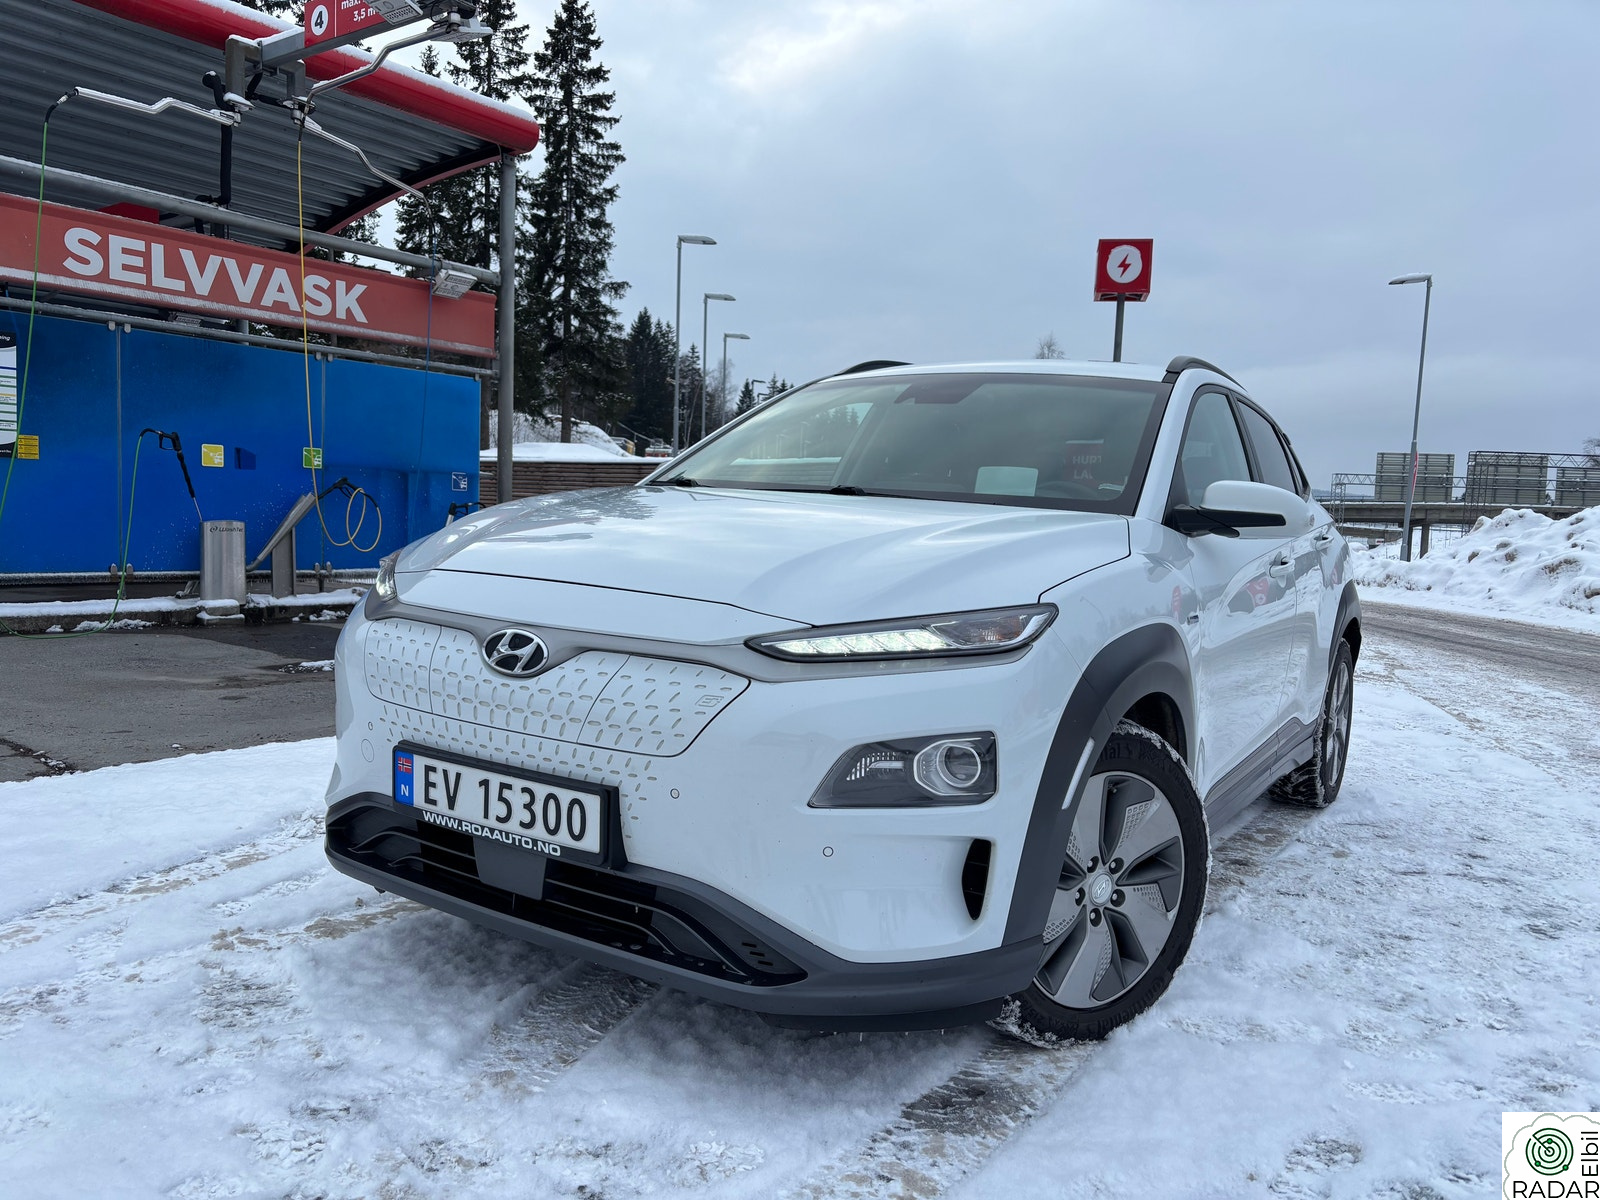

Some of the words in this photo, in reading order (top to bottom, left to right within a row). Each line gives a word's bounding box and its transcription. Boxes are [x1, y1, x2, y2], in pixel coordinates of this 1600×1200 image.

[314, 11, 324, 28] 4
[353, 8, 366, 21] 3,5
[62, 227, 369, 324] SELVVASK
[401, 784, 410, 798] N
[424, 764, 462, 811] EV
[478, 778, 587, 842] 15300
[422, 810, 561, 857] WWW.ROAAUTO.NO
